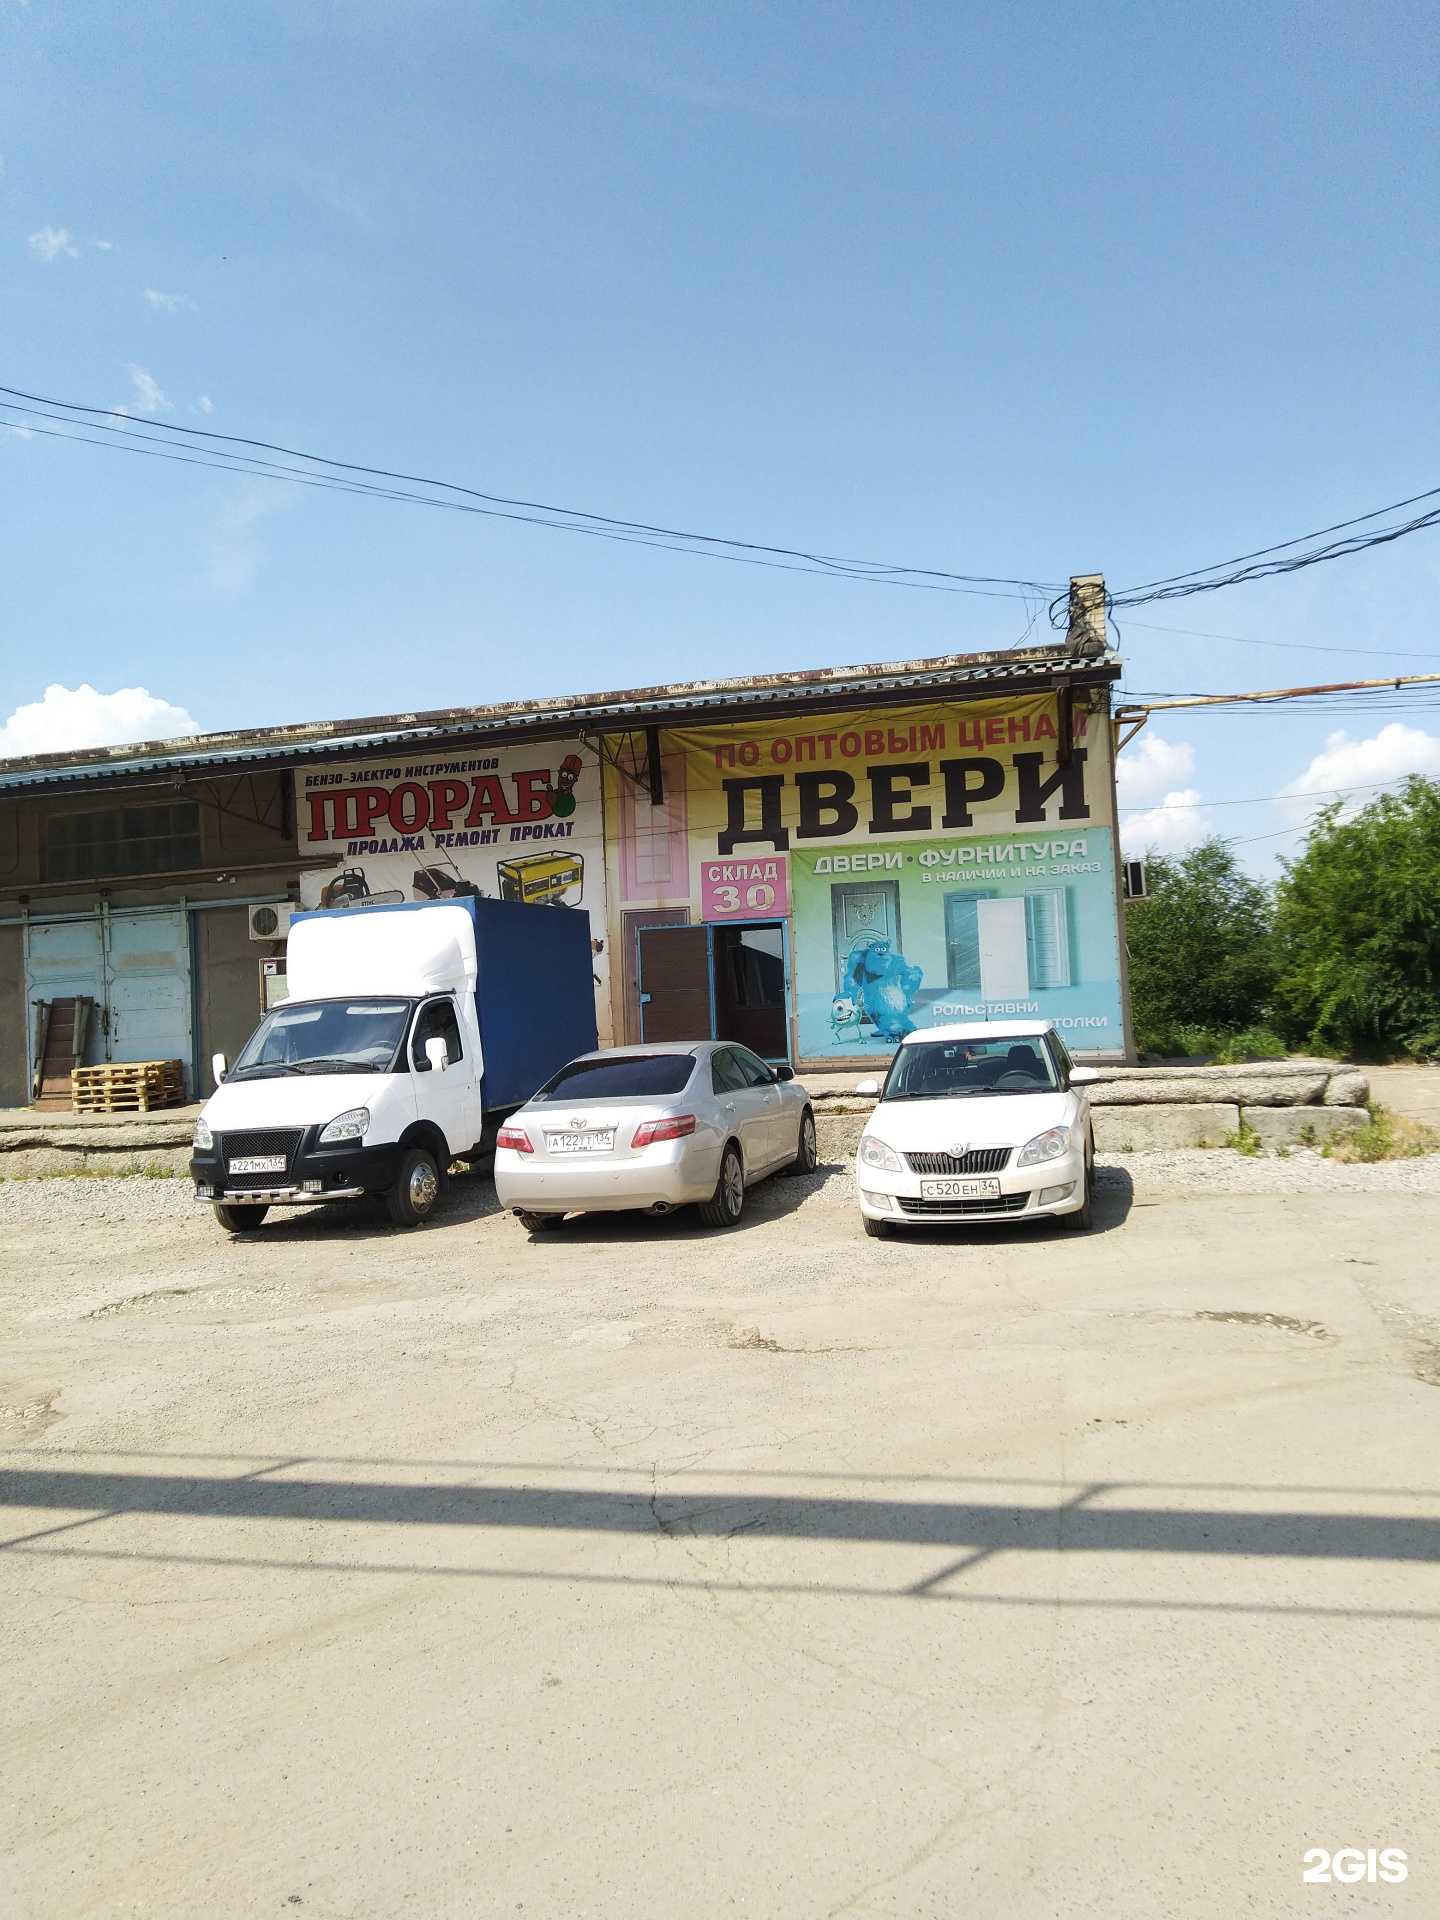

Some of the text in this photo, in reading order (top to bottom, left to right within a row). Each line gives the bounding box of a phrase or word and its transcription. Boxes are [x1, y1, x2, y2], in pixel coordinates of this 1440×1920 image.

[715, 742, 760, 768] ПО
[771, 720, 945, 764] ОПТОВЫМ
[305, 757, 499, 787] БЕНЗО-ЭЛЕКТРО ИНСТРУМЕНТОВ
[306, 768, 555, 842] ПРОРАБ
[717, 747, 1091, 855] ДВЕРИ
[347, 821, 574, 856] ПРОДАЖА РЕМОНТ ПРОКАТ
[708, 862, 778, 882] СКЛАД
[813, 838, 1089, 875] ДВЕРИ ФУРНИТУРА
[921, 861, 1101, 883] В НАЛИЧИИ И НА ЗАКАЗ
[712, 883, 776, 913] 30
[933, 1001, 1039, 1017] РОЛЬСТАВНИ
